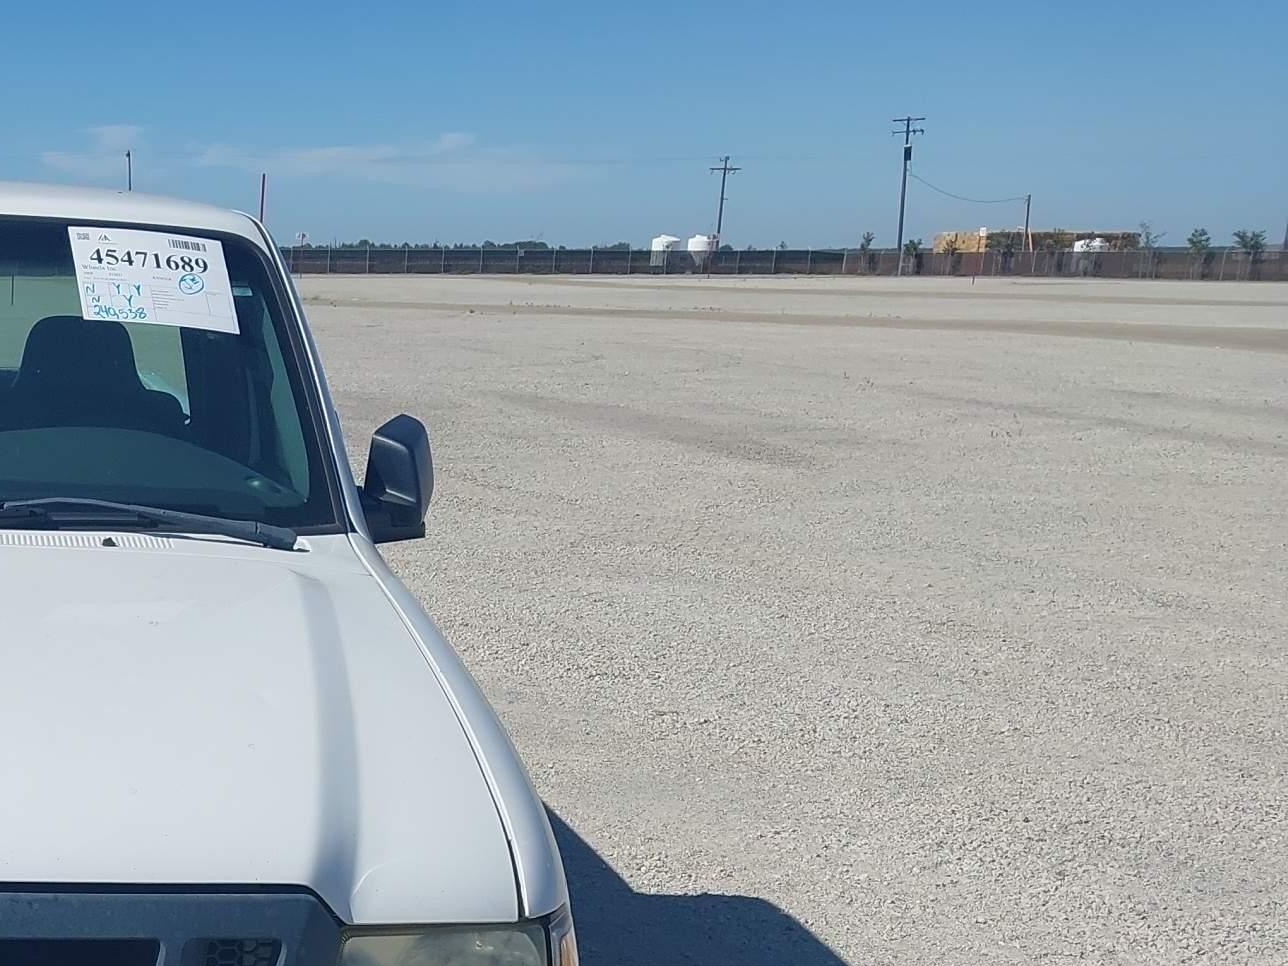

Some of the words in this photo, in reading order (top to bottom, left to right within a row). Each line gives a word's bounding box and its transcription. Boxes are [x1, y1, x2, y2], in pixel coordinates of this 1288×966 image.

[89, 247, 209, 274] 45471689
[112, 281, 121, 295] Y
[133, 284, 142, 297] Y
[122, 294, 134, 308] Y
